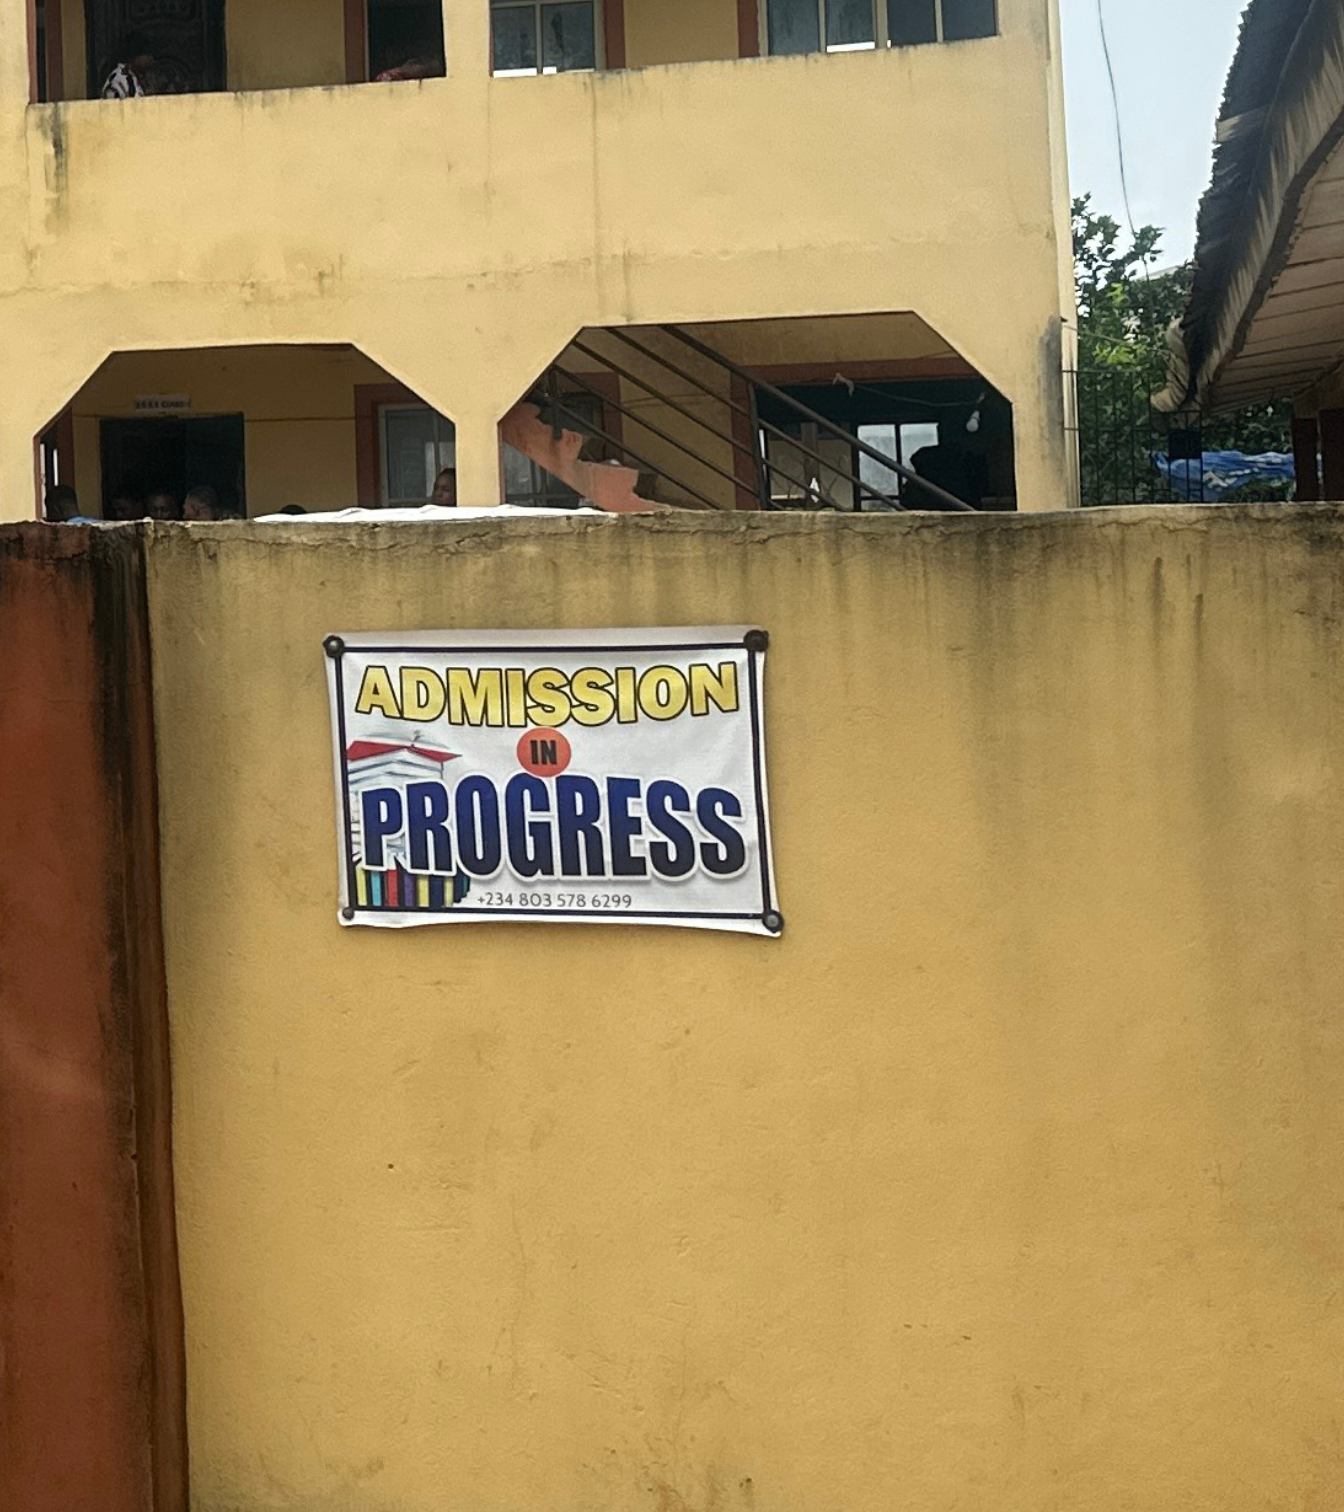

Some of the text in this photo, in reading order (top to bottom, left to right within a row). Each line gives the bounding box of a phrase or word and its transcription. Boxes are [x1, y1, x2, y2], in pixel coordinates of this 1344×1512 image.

[356, 661, 740, 728] ADMISSION
[530, 740, 558, 766] IN
[361, 772, 746, 879] PROGRESS
[477, 892, 632, 908] +234 803 578 6299
